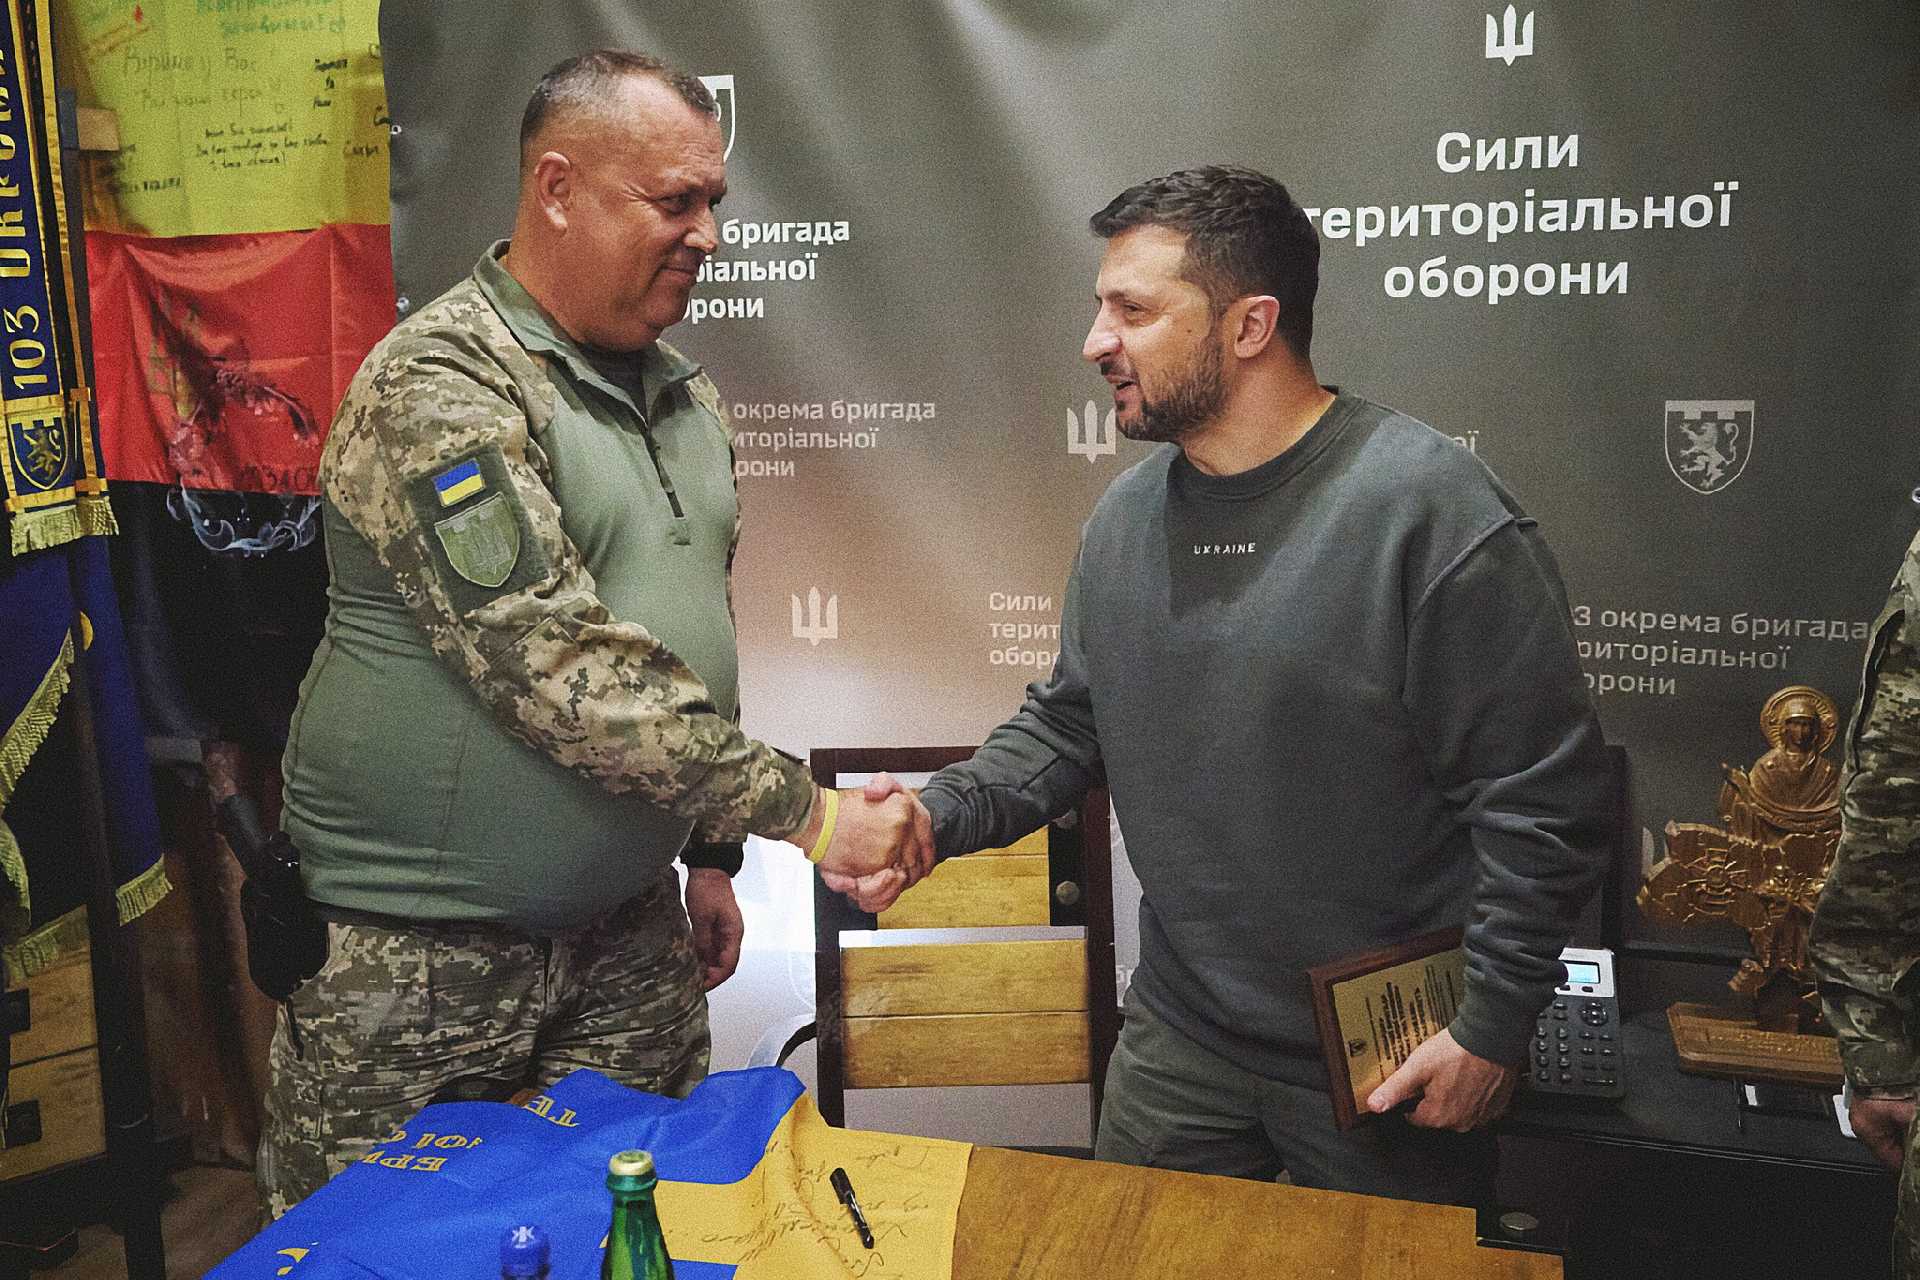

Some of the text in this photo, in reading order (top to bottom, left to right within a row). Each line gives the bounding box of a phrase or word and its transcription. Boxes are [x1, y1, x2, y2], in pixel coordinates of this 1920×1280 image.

[1436, 132, 1580, 173] Сили
[722, 218, 850, 249] бригада
[1384, 256, 1629, 305] оборони
[684, 297, 764, 324] рони
[3, 304, 48, 390] 103
[734, 399, 936, 423] окрема бригада
[1193, 542, 1257, 555] UKRAINE
[989, 592, 1052, 611] Сили
[1600, 610, 1721, 634] окрема
[1731, 612, 1869, 642] бригада
[989, 646, 1056, 670] обор
